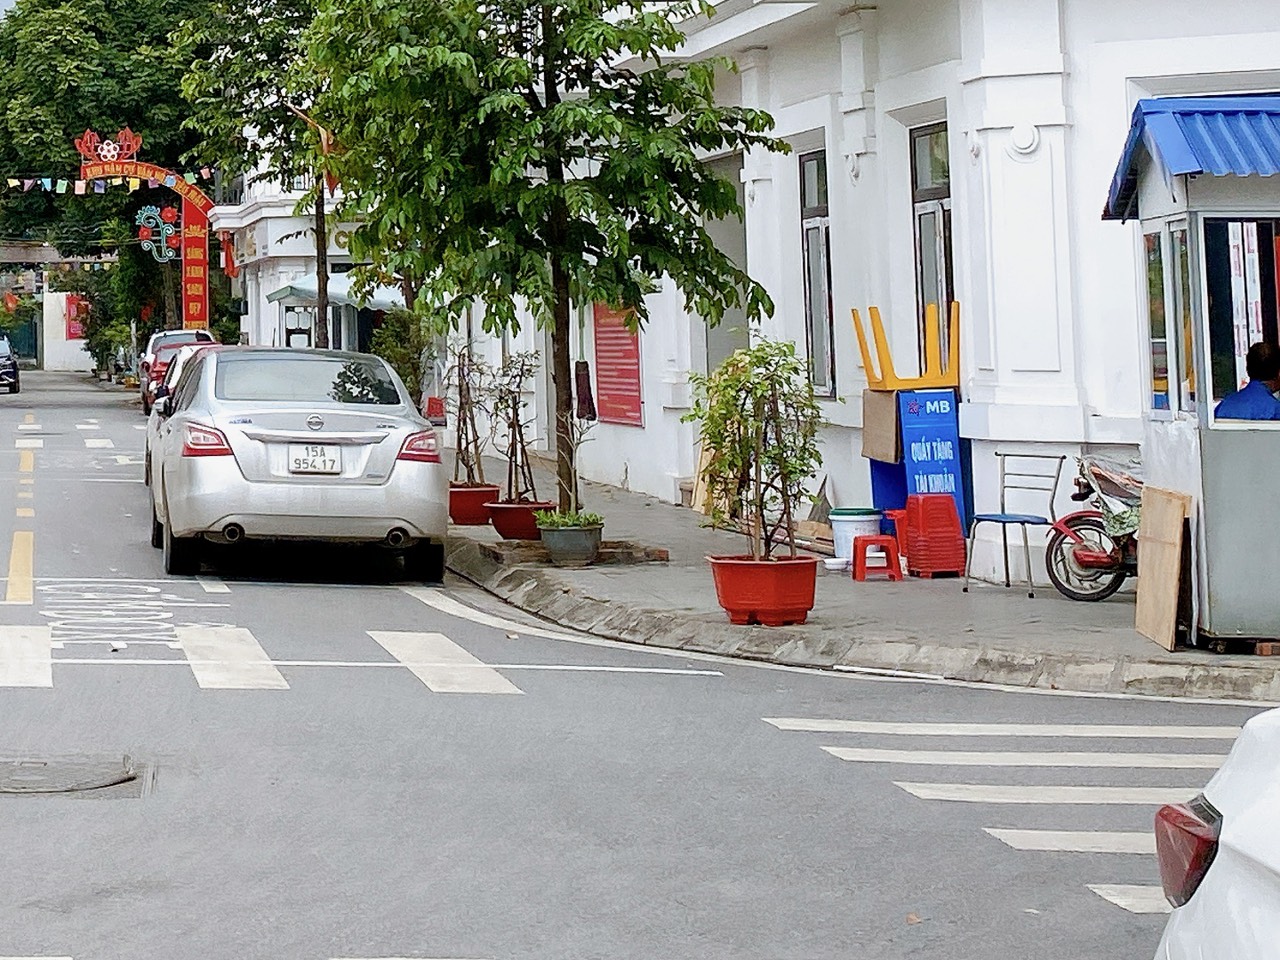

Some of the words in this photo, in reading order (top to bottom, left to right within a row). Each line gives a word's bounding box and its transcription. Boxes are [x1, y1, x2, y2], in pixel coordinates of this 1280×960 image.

[925, 400, 951, 414] MB
[304, 446, 326, 458] 15A
[294, 459, 336, 471] 954.17
